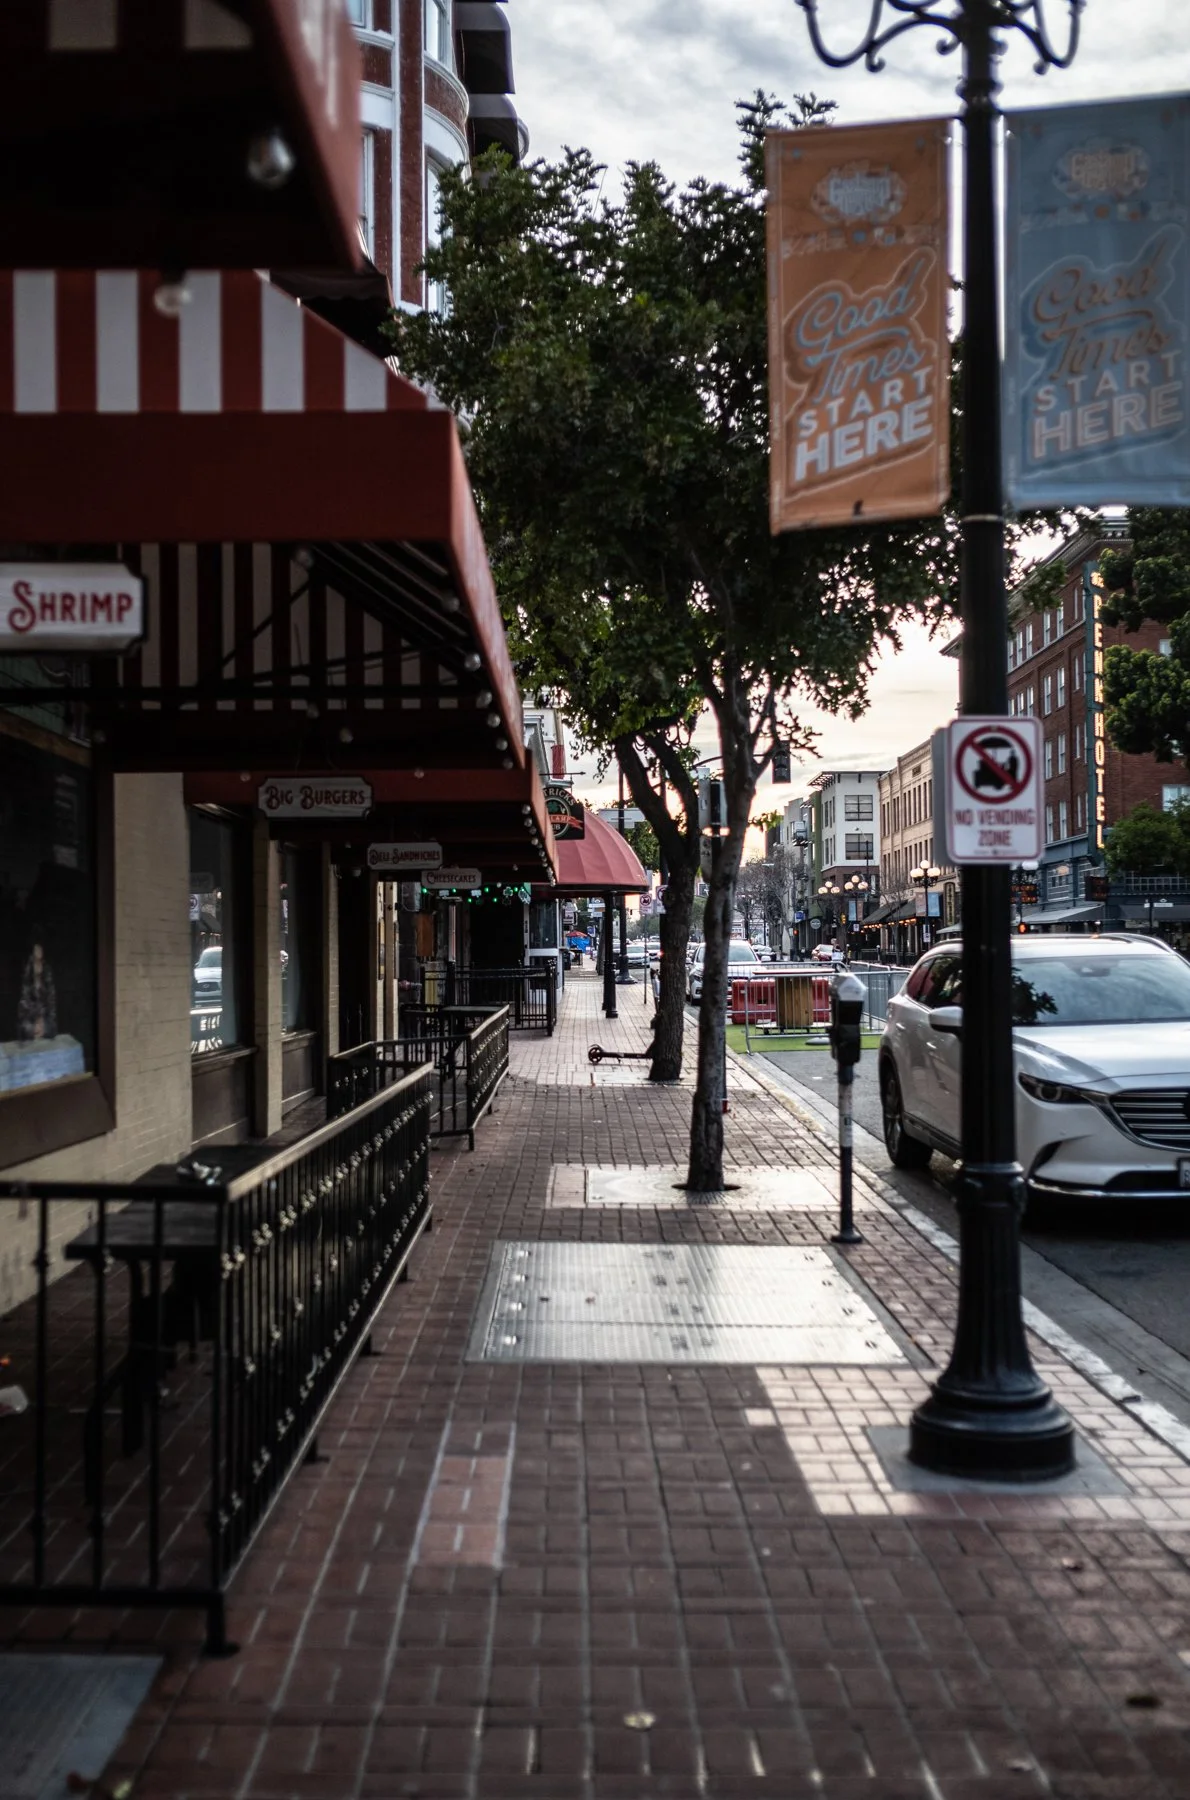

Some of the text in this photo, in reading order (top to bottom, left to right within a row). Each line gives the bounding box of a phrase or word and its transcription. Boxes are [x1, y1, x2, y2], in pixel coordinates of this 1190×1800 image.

[796, 258, 925, 352] Good
[1032, 237, 1168, 333] Good
[806, 327, 925, 403] Times
[1041, 309, 1173, 381] Times
[798, 365, 933, 437] START
[1034, 350, 1182, 416] START
[794, 395, 933, 482] HERE
[1032, 380, 1184, 459] HERE
[7, 579, 134, 634] SHRIMP
[266, 785, 366, 810] BIG BURGERS
[543, 787, 576, 806] TRICKS
[955, 808, 1037, 825] NO VENDING
[1094, 712, 1105, 849] HOTEL
[978, 829, 1012, 846] ZONE
